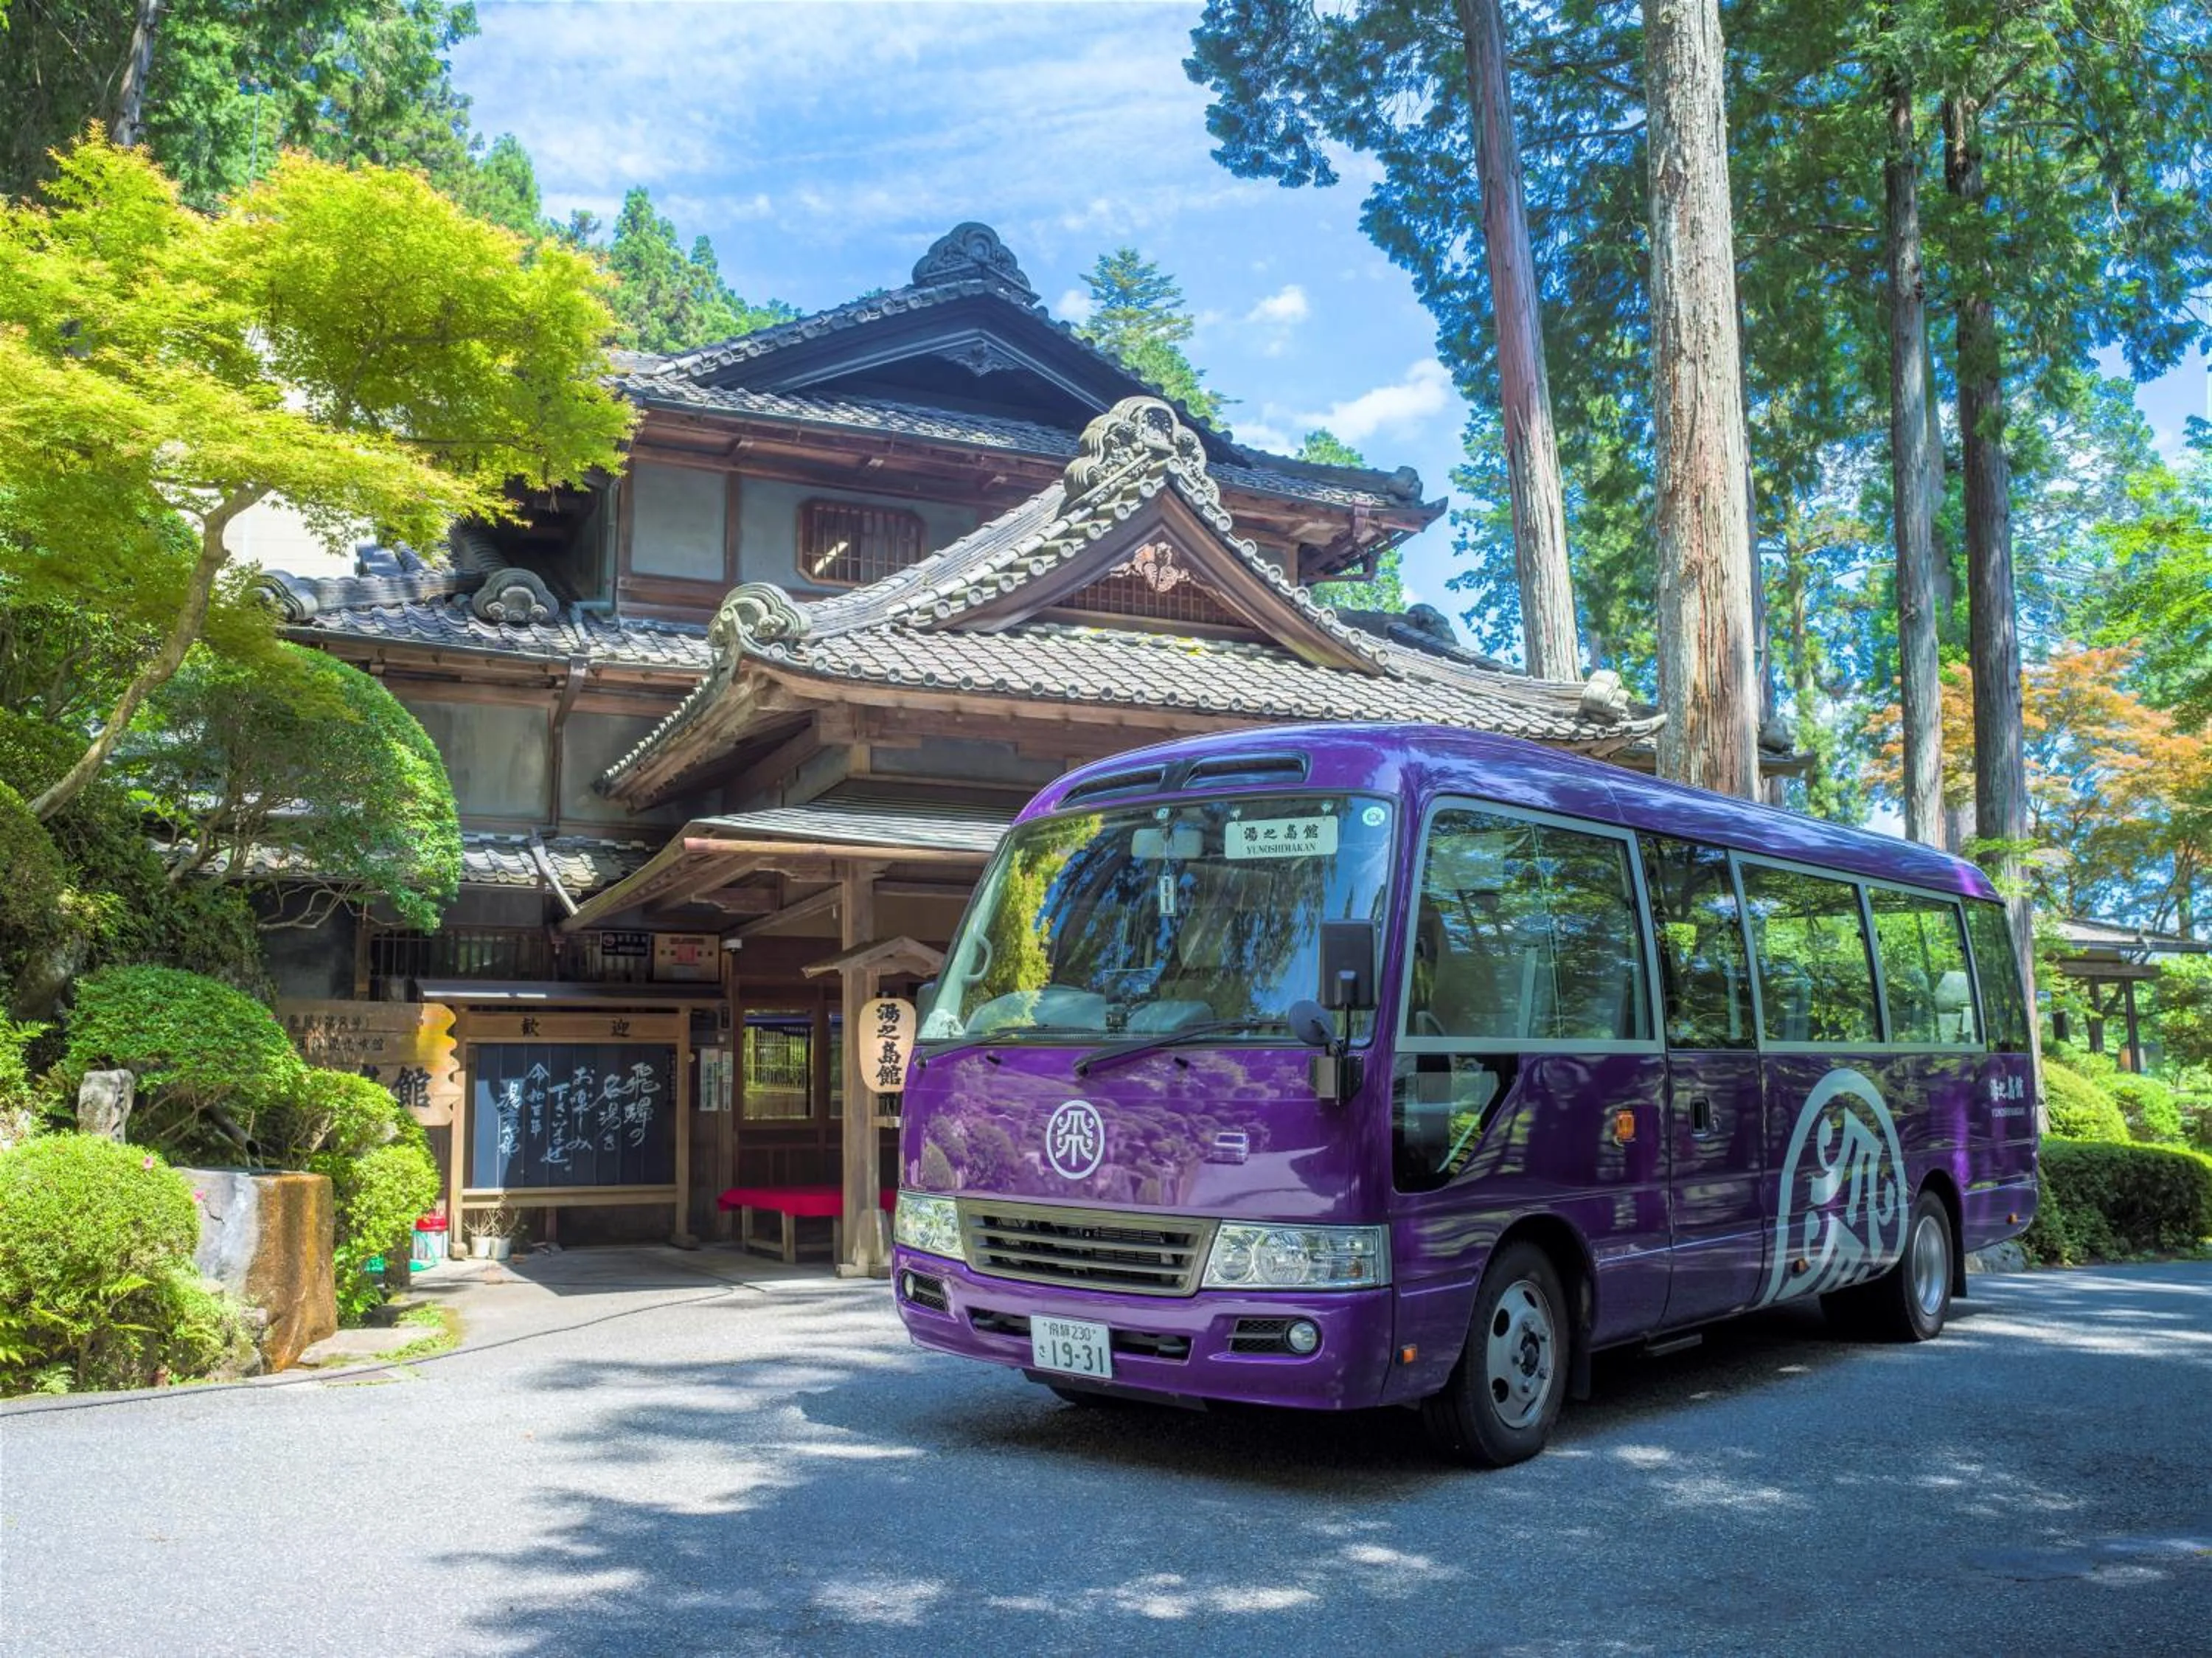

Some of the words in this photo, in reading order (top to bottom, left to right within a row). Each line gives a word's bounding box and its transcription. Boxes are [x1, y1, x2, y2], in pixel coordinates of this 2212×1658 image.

[1247, 843, 1316, 854] YUNOSHIMAKAN
[876, 1003, 902, 1086] 湯之島館
[1052, 1339, 1104, 1374] 19-31
